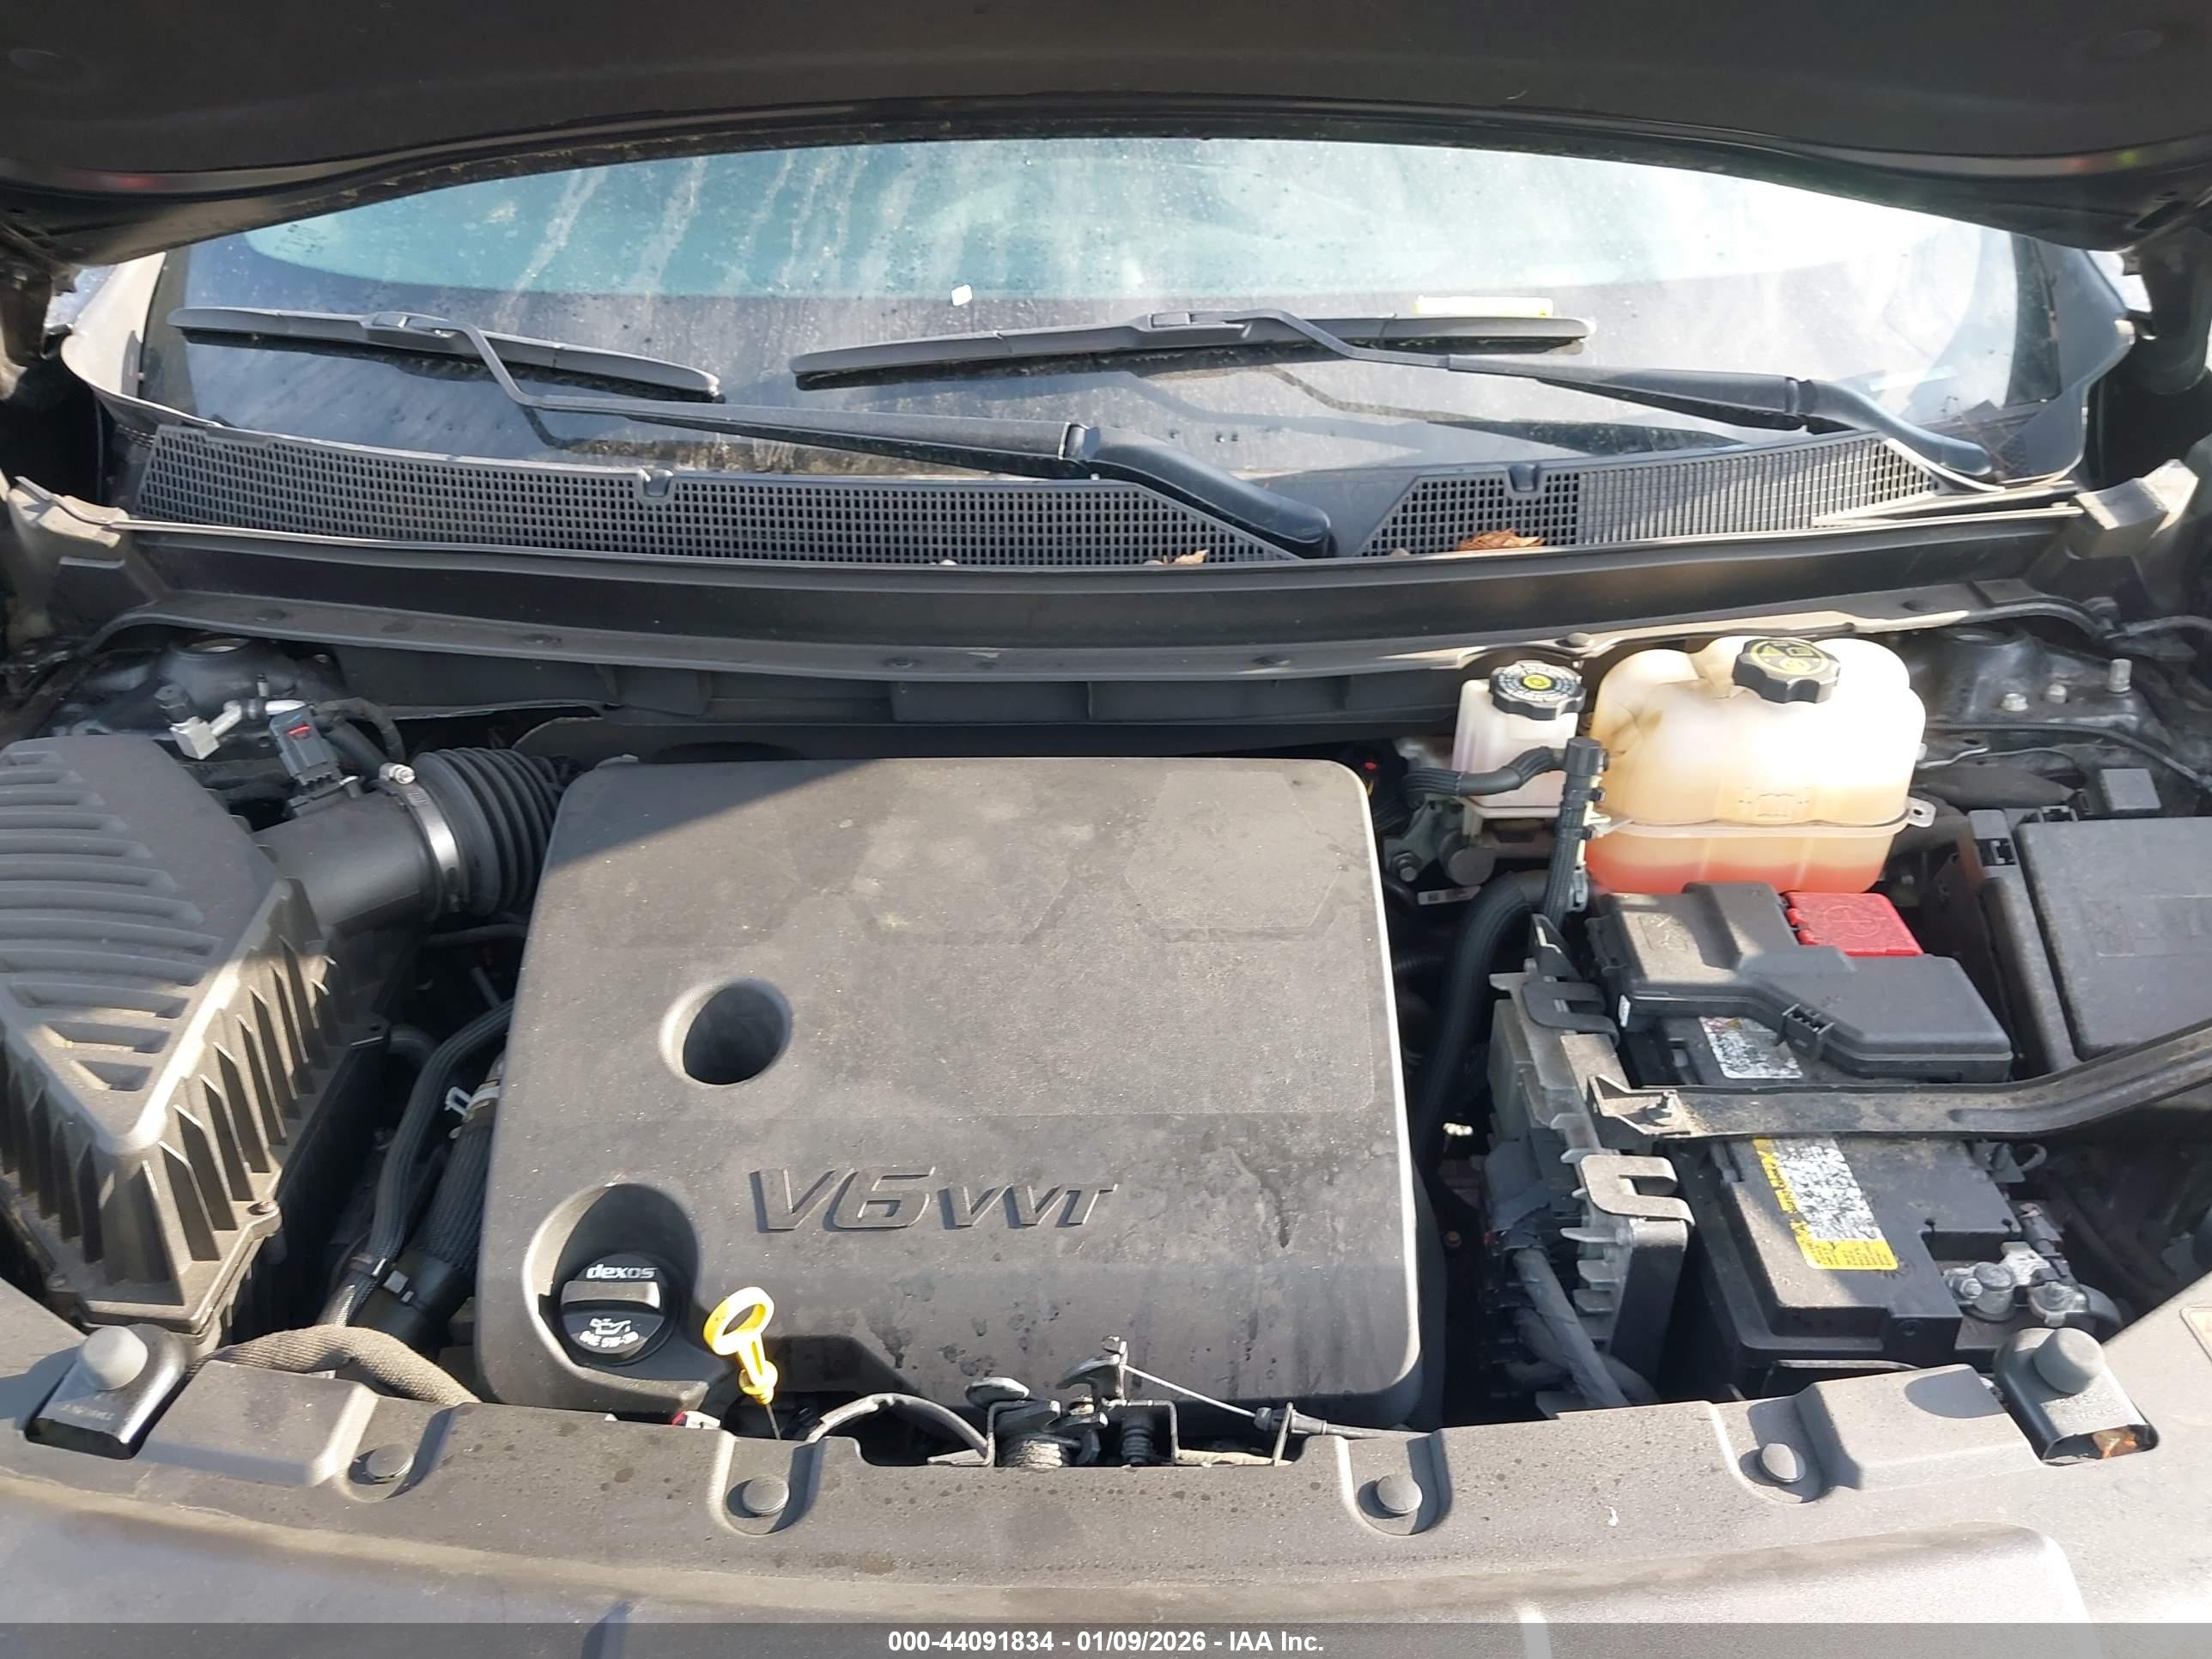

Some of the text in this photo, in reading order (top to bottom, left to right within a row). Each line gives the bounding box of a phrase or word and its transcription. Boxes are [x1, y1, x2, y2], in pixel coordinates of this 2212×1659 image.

[750, 1166, 1118, 1233] V6 VVT
[586, 1263, 659, 1279] dexos
